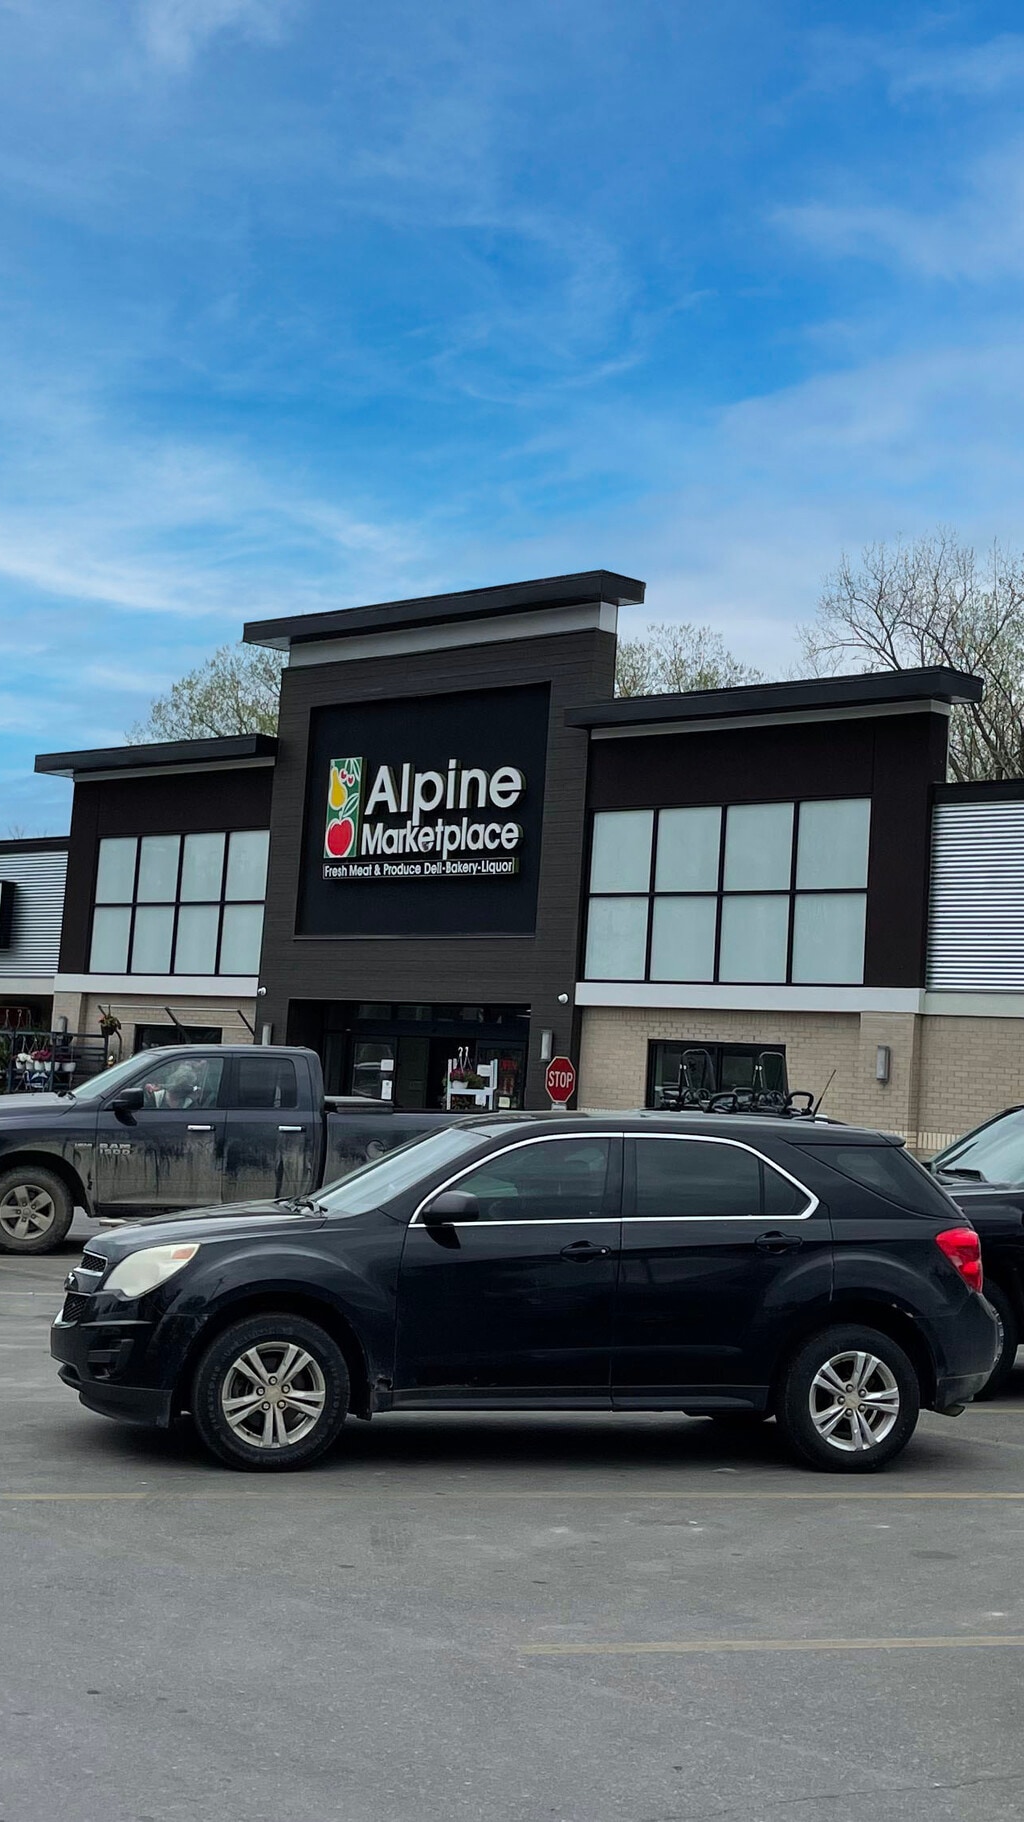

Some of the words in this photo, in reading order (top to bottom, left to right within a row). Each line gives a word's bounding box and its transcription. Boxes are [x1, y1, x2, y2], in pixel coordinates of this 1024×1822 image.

[364, 759, 524, 826] Alpine
[361, 817, 523, 860] Marketplace
[324, 865, 347, 877] Fresh
[349, 864, 372, 877] Meat
[374, 863, 381, 876] &
[383, 862, 421, 876] Produce
[548, 1071, 573, 1089] STOP
